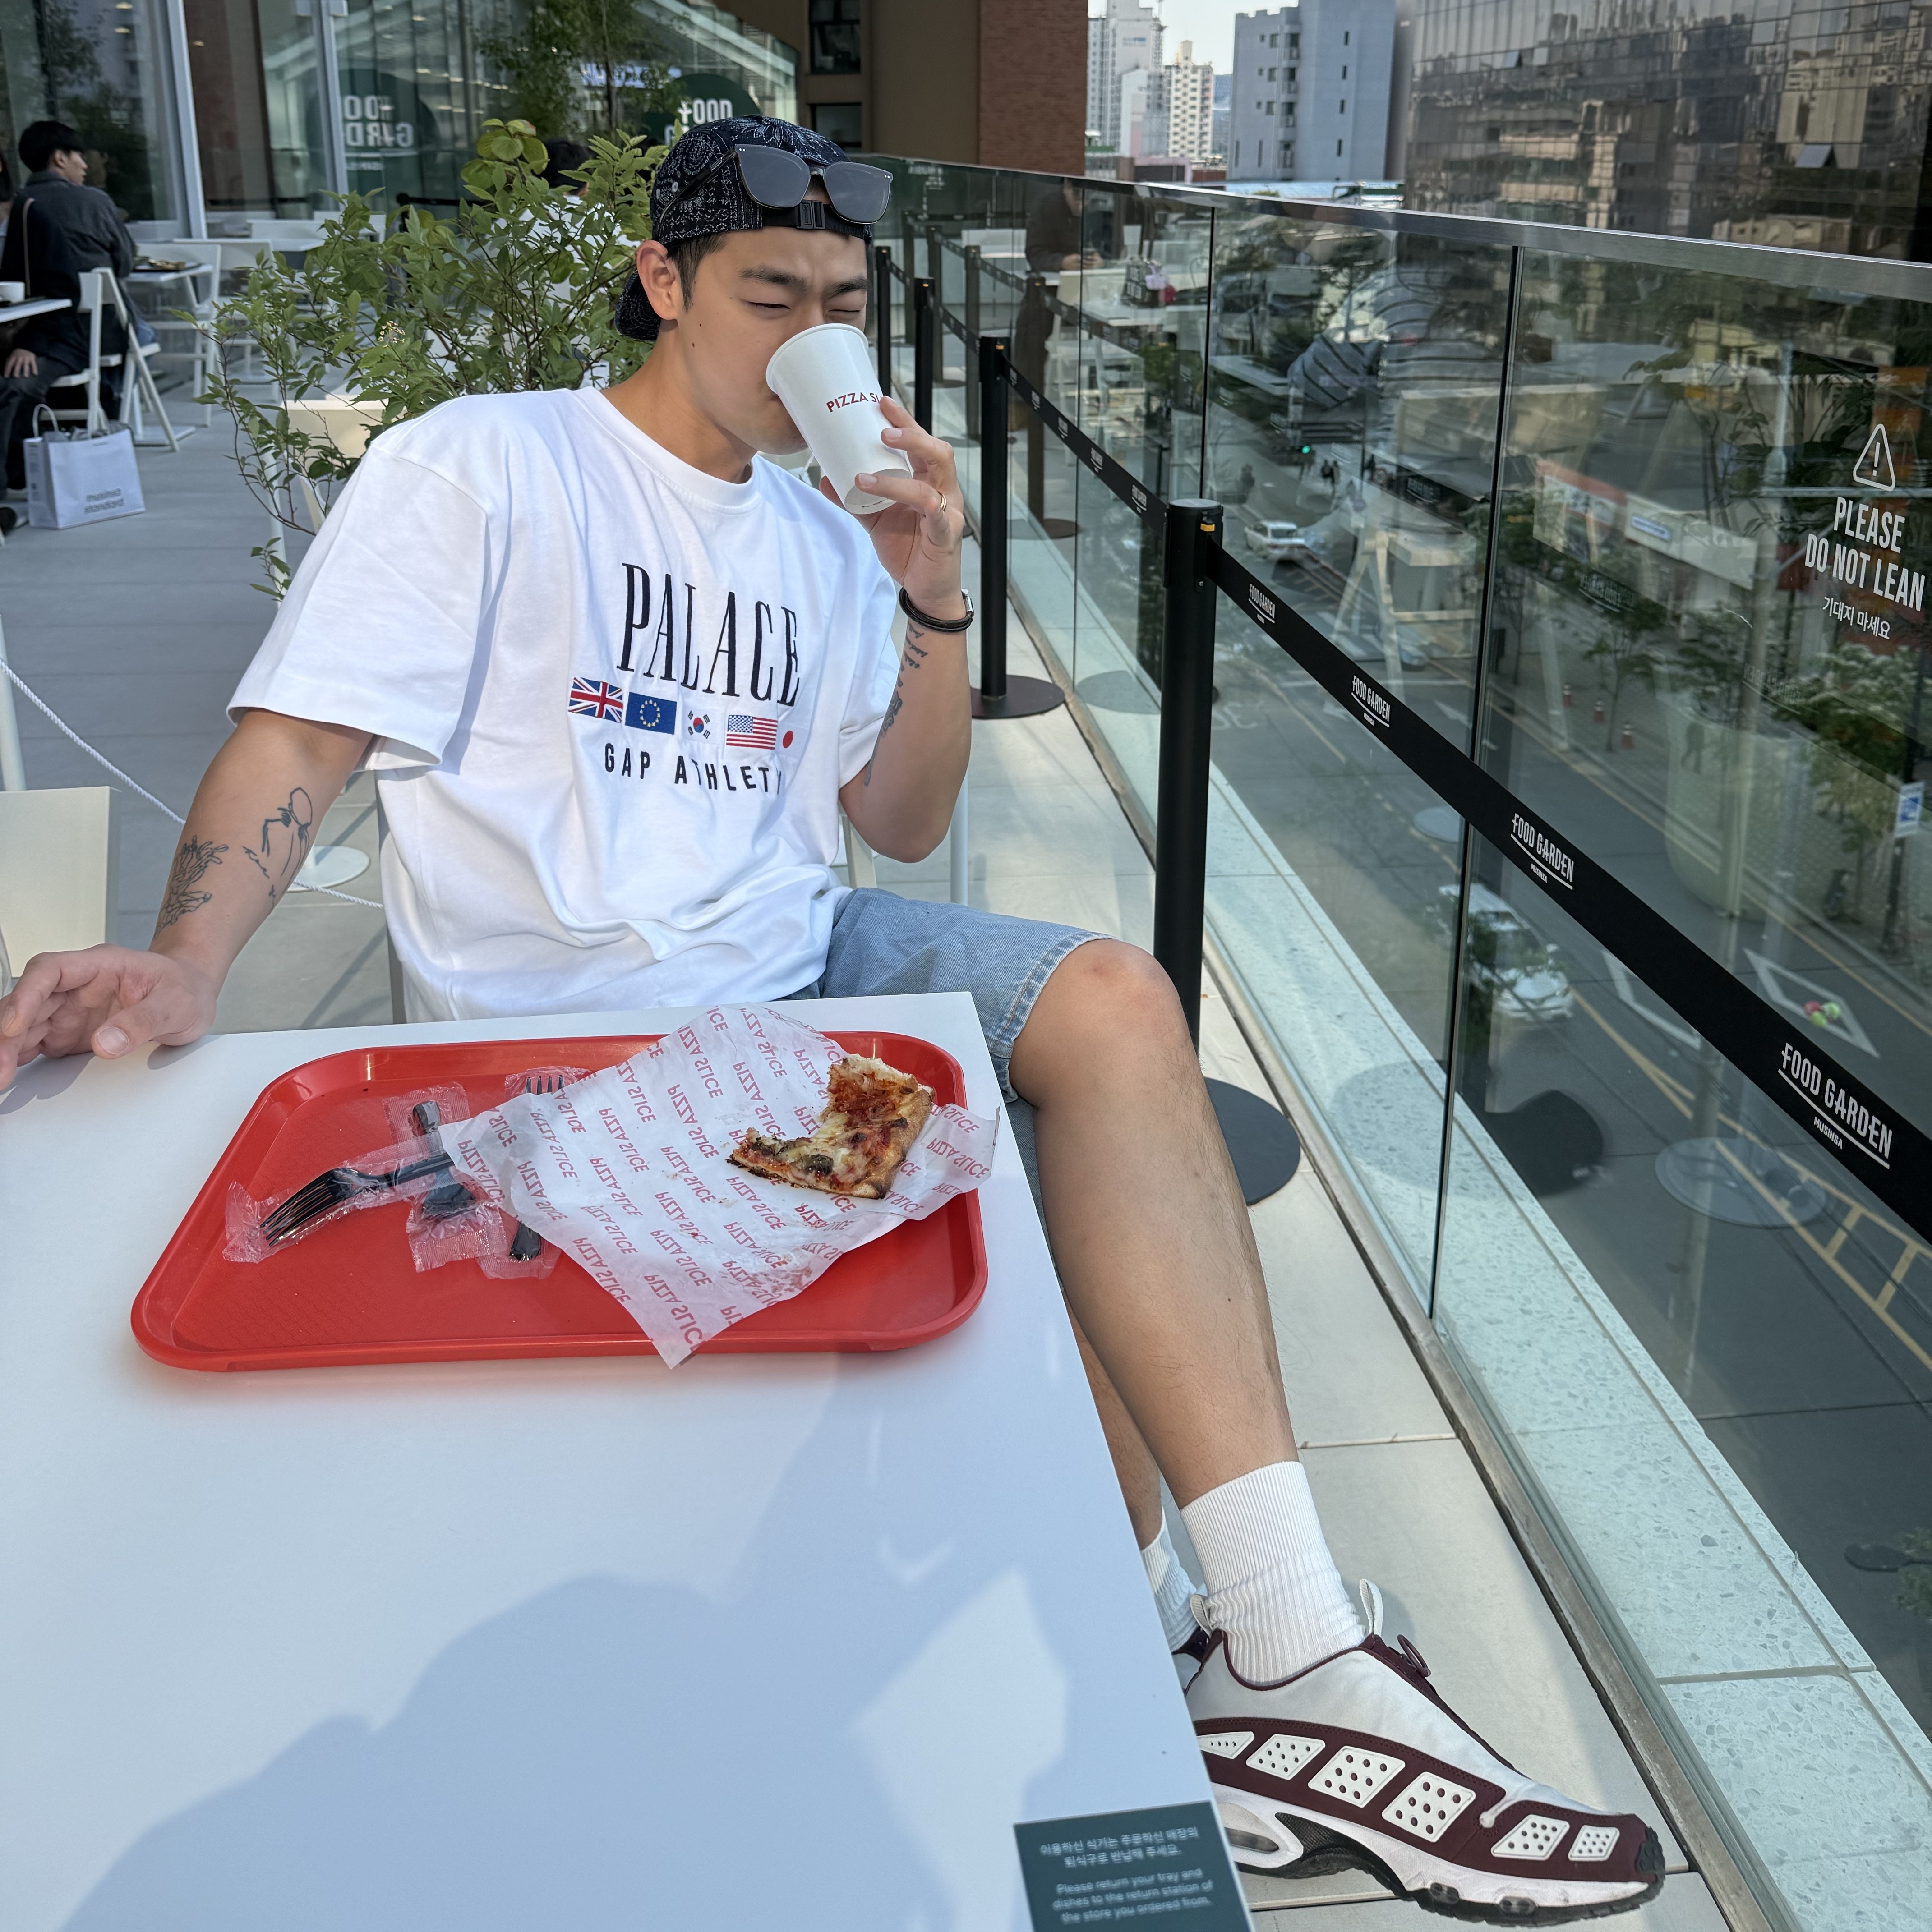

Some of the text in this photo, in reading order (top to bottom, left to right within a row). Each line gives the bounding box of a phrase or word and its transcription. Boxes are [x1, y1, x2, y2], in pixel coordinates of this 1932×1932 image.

[826, 392, 869, 413] PIZZA
[1833, 496, 1905, 553] PLEASE
[1805, 533, 1925, 612] DO NOT LEAN
[617, 563, 800, 707] PALACE
[1822, 597, 1890, 640] 기대지 마세요
[1352, 675, 1367, 700] FOOD
[1367, 687, 1390, 722] GARDEN
[604, 742, 781, 795] GAP ATHLET
[1512, 813, 1574, 883] FOOD GARDEN
[1781, 1042, 1893, 1159] FOOD GARDEN
[1813, 1116, 1843, 1150] MUSINSA
[1052, 1879, 1213, 1911] dishes to the return station of
[1056, 1867, 1203, 1894] Please return your tray and
[1061, 1912, 1081, 1924] the
[1083, 1909, 1112, 1921] store
[1113, 1907, 1135, 1920] you
[1136, 1899, 1181, 1915] ordered
